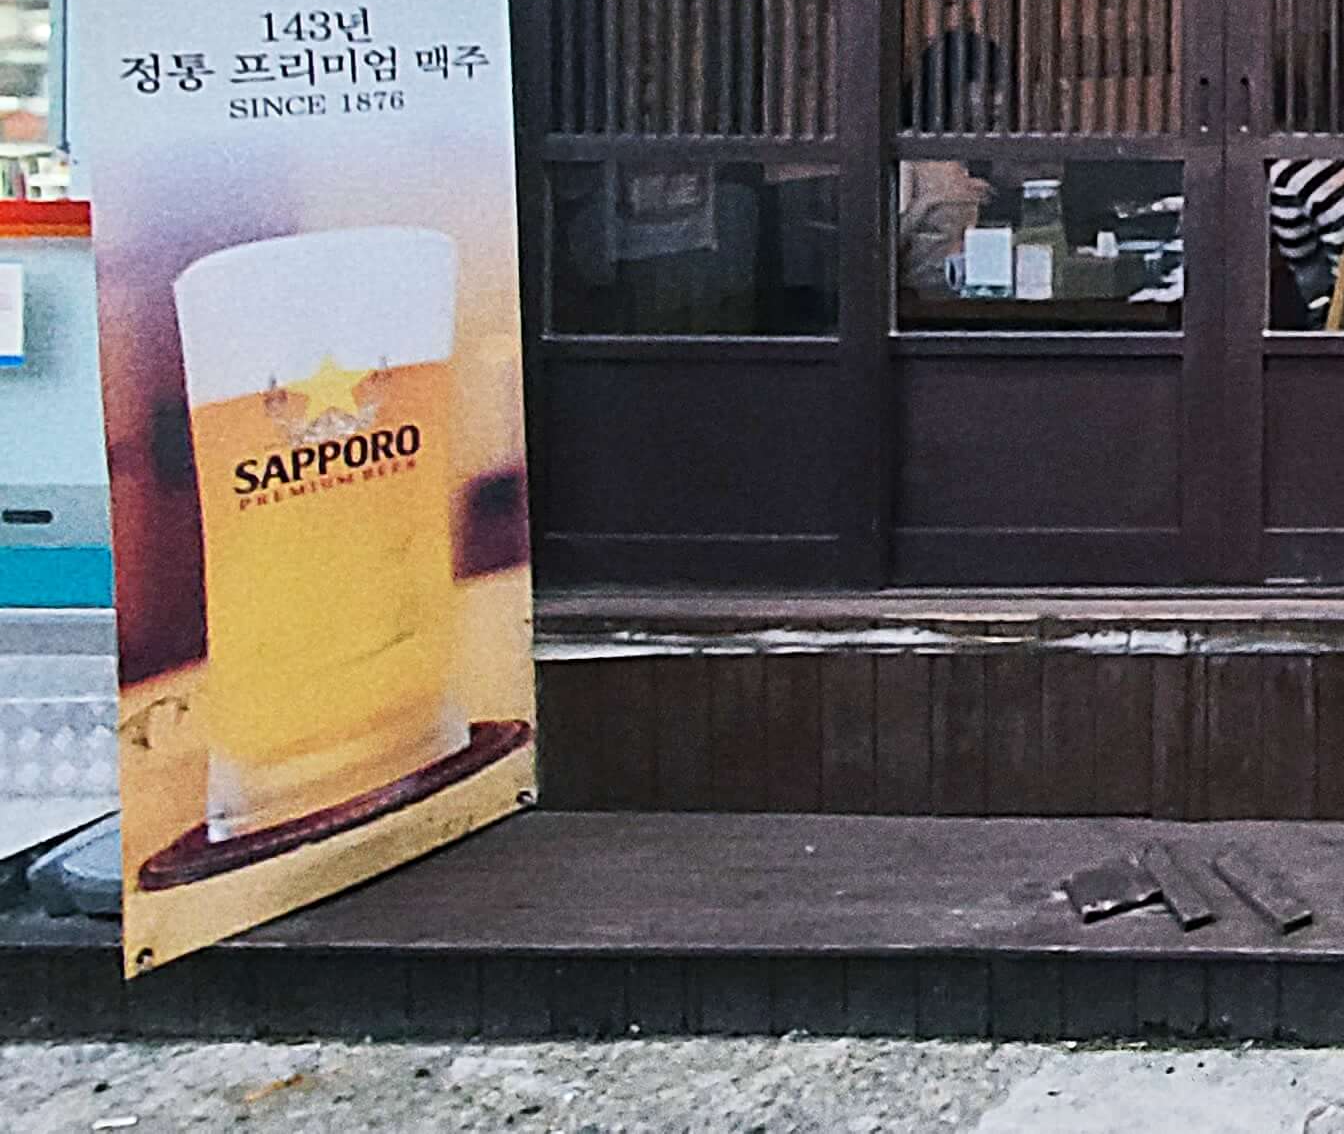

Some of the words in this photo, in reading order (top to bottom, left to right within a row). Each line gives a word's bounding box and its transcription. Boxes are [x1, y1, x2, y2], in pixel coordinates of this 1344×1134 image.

[259, 7, 374, 45] 143년
[120, 51, 216, 95] 정통
[229, 45, 398, 86] 프리미엄
[414, 43, 491, 81] 맥주
[228, 93, 327, 120] SINCE
[341, 90, 406, 113] 1876
[233, 424, 421, 495] SAPPORO
